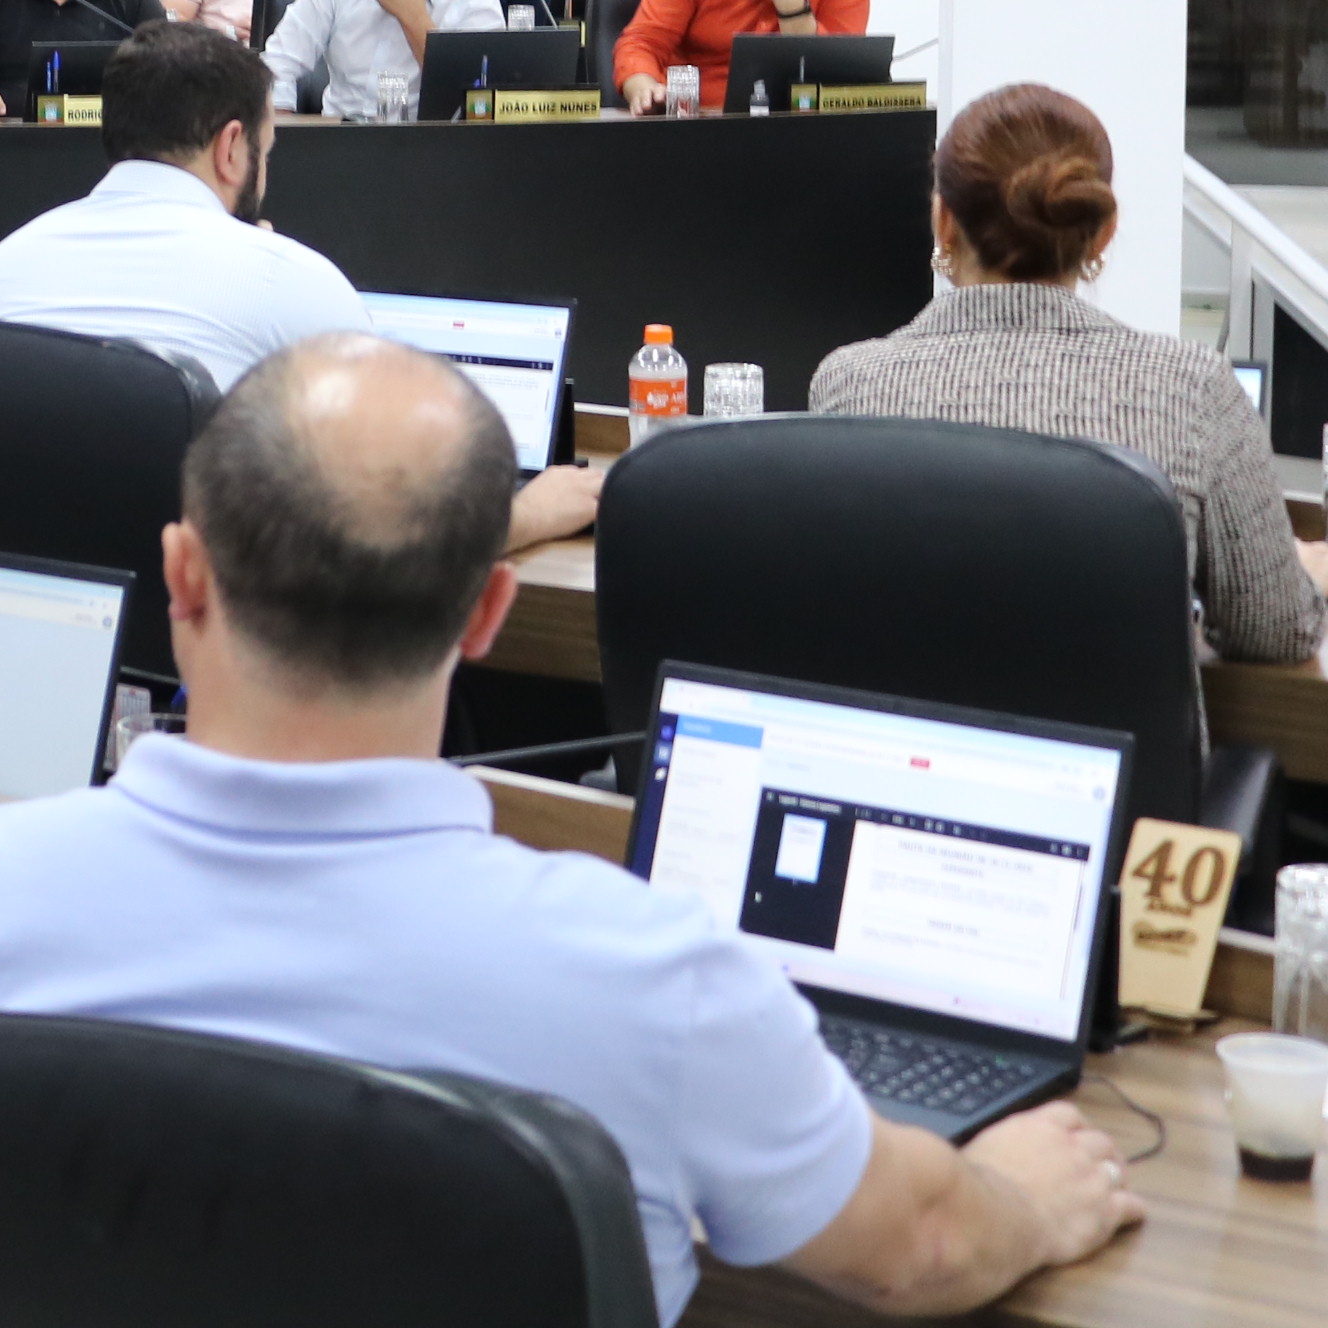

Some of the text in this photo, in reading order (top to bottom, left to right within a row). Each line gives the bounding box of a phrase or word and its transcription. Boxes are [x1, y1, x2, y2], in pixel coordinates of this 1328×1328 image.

[533, 102, 555, 113] LUIZ
[561, 102, 596, 113] NUNES
[1132, 839, 1225, 906] 40
